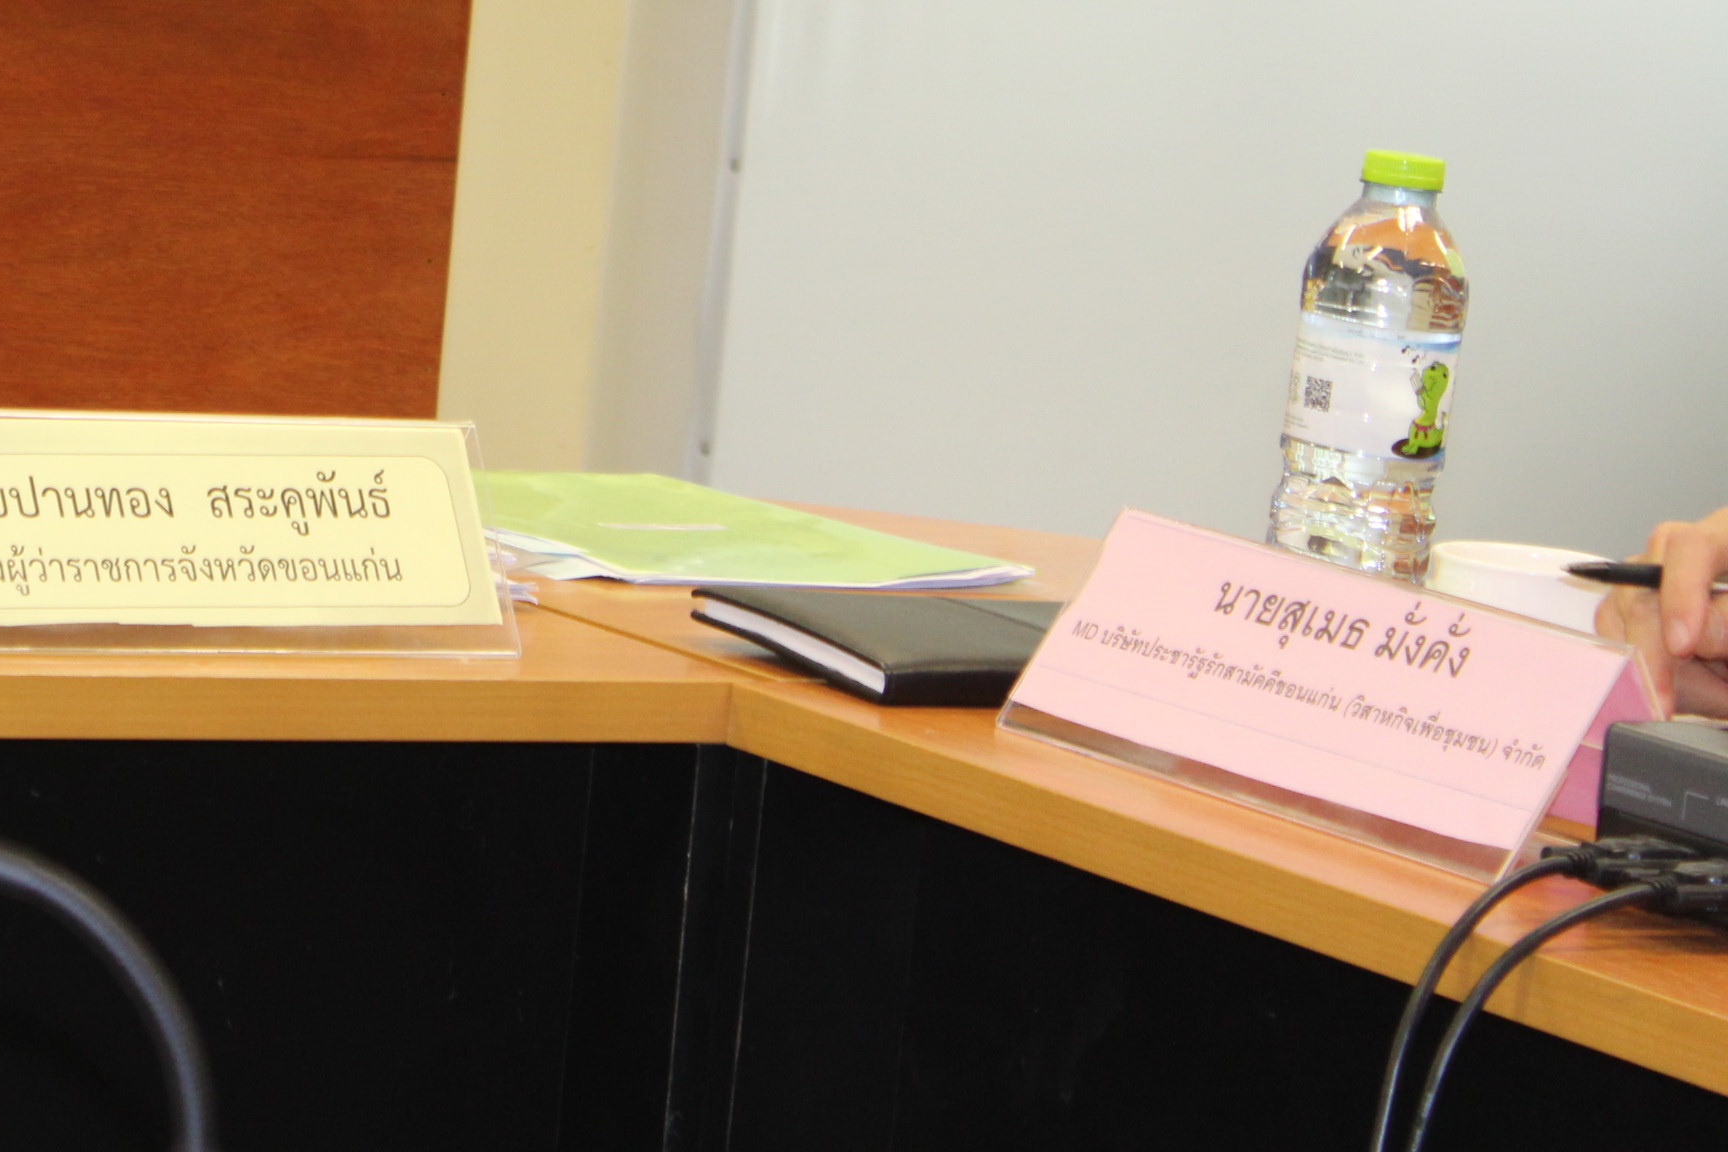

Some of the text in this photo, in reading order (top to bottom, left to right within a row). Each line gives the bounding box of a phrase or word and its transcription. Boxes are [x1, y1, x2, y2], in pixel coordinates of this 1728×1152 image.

[206, 469, 392, 537] สระคูพันธ์
[1214, 581, 1472, 678] นายสุเมธ มั่งคั่ง
[1072, 620, 1099, 640] MD
[1503, 739, 1546, 770] จำกัด
